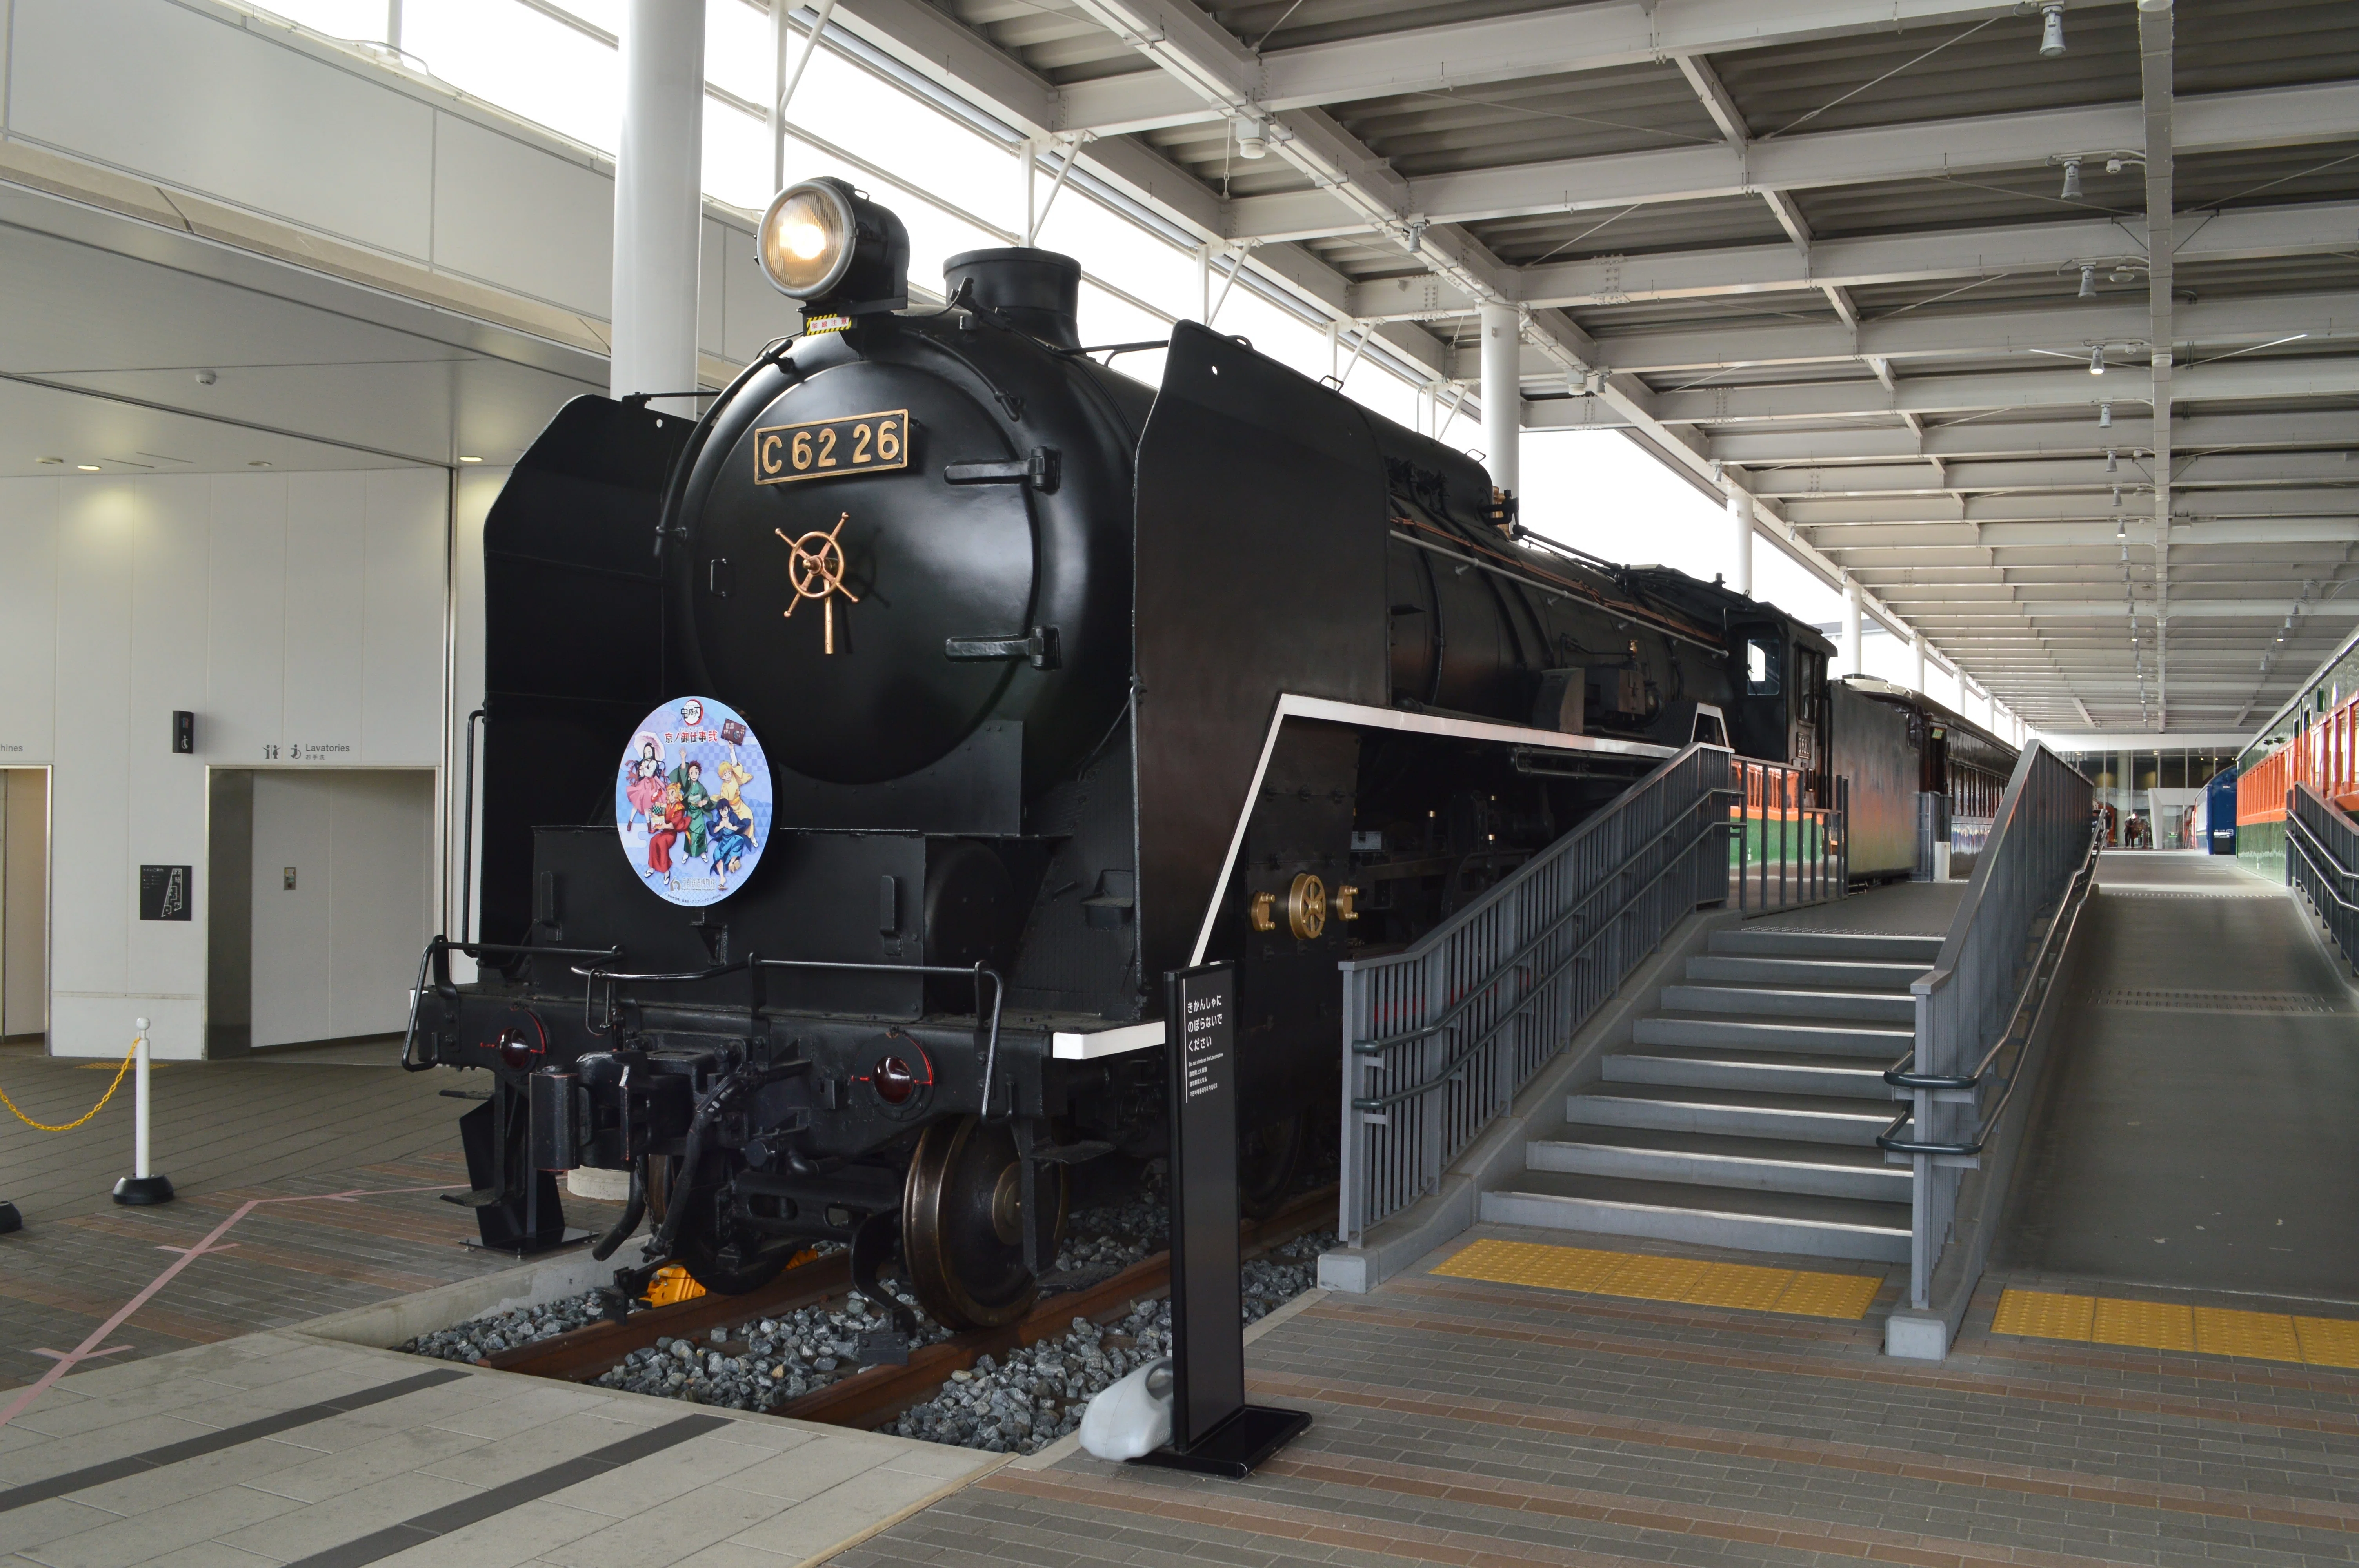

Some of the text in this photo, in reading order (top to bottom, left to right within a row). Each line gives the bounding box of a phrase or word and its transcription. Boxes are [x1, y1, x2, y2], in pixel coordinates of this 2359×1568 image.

[1187, 995, 1221, 1013] きかんしゃに
[1188, 1013, 1223, 1033] のぼらないで
[1189, 1036, 1212, 1052] ください
